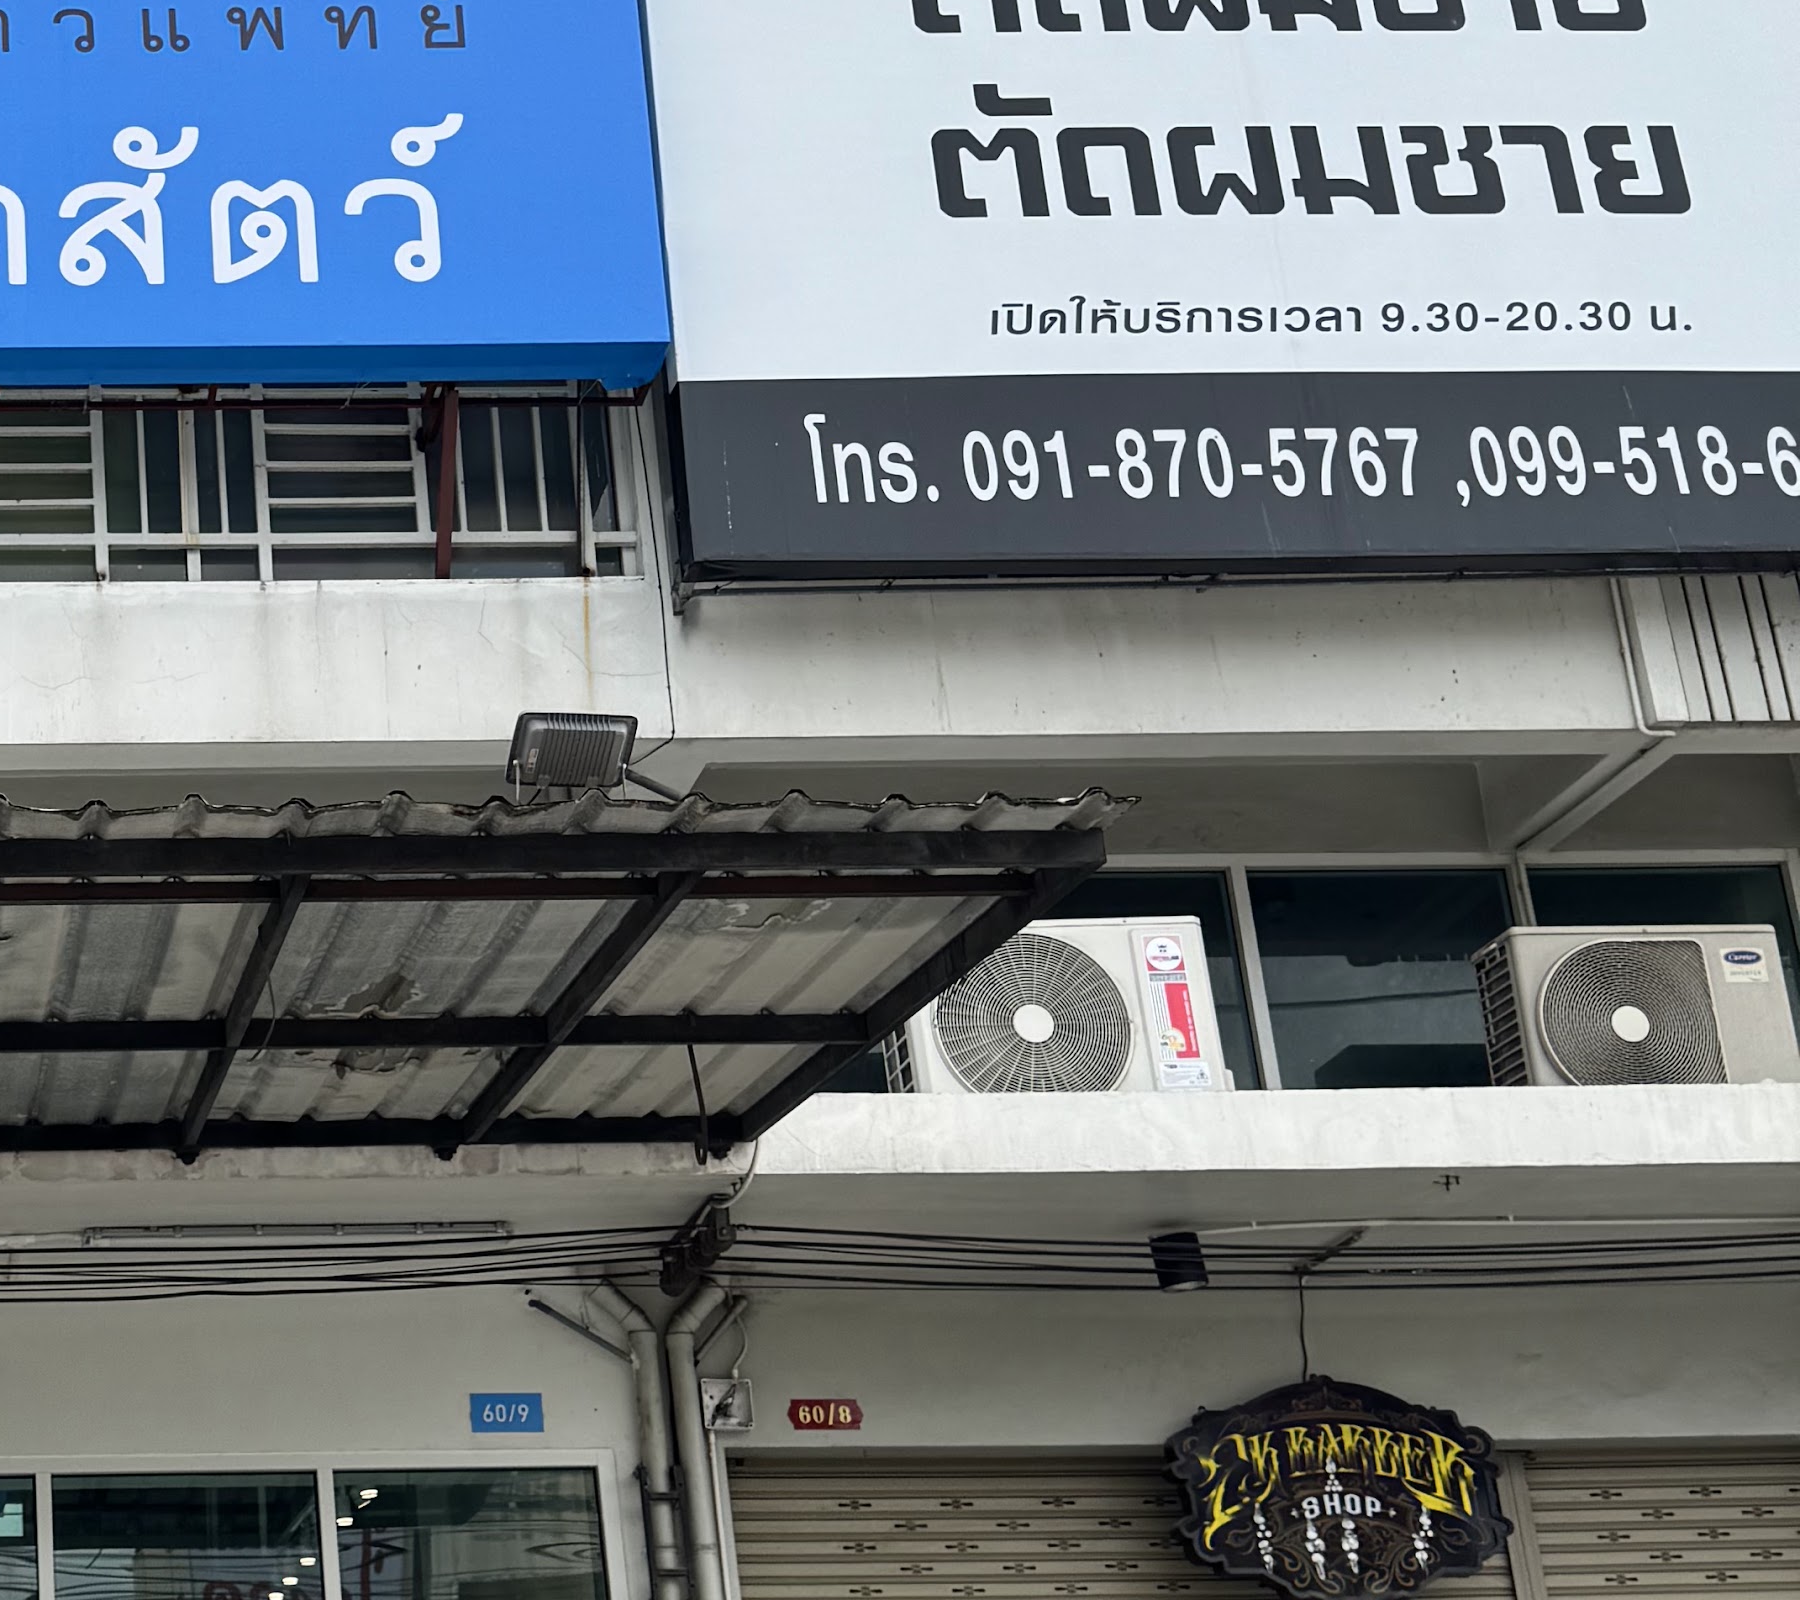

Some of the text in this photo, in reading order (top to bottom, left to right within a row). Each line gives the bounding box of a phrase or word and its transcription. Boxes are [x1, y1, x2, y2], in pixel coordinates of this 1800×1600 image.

[930, 83, 1693, 218] ตัดผมชาย
[990, 294, 1693, 336] เปิดให้บริการเวลา 9.30-20.30 น.
[803, 412, 940, 506] โทร.
[962, 426, 1420, 504] 091-870-5767
[482, 1403, 529, 1423] 60/9
[798, 1404, 853, 1425] 60/8
[1301, 1492, 1383, 1519] SHOP
